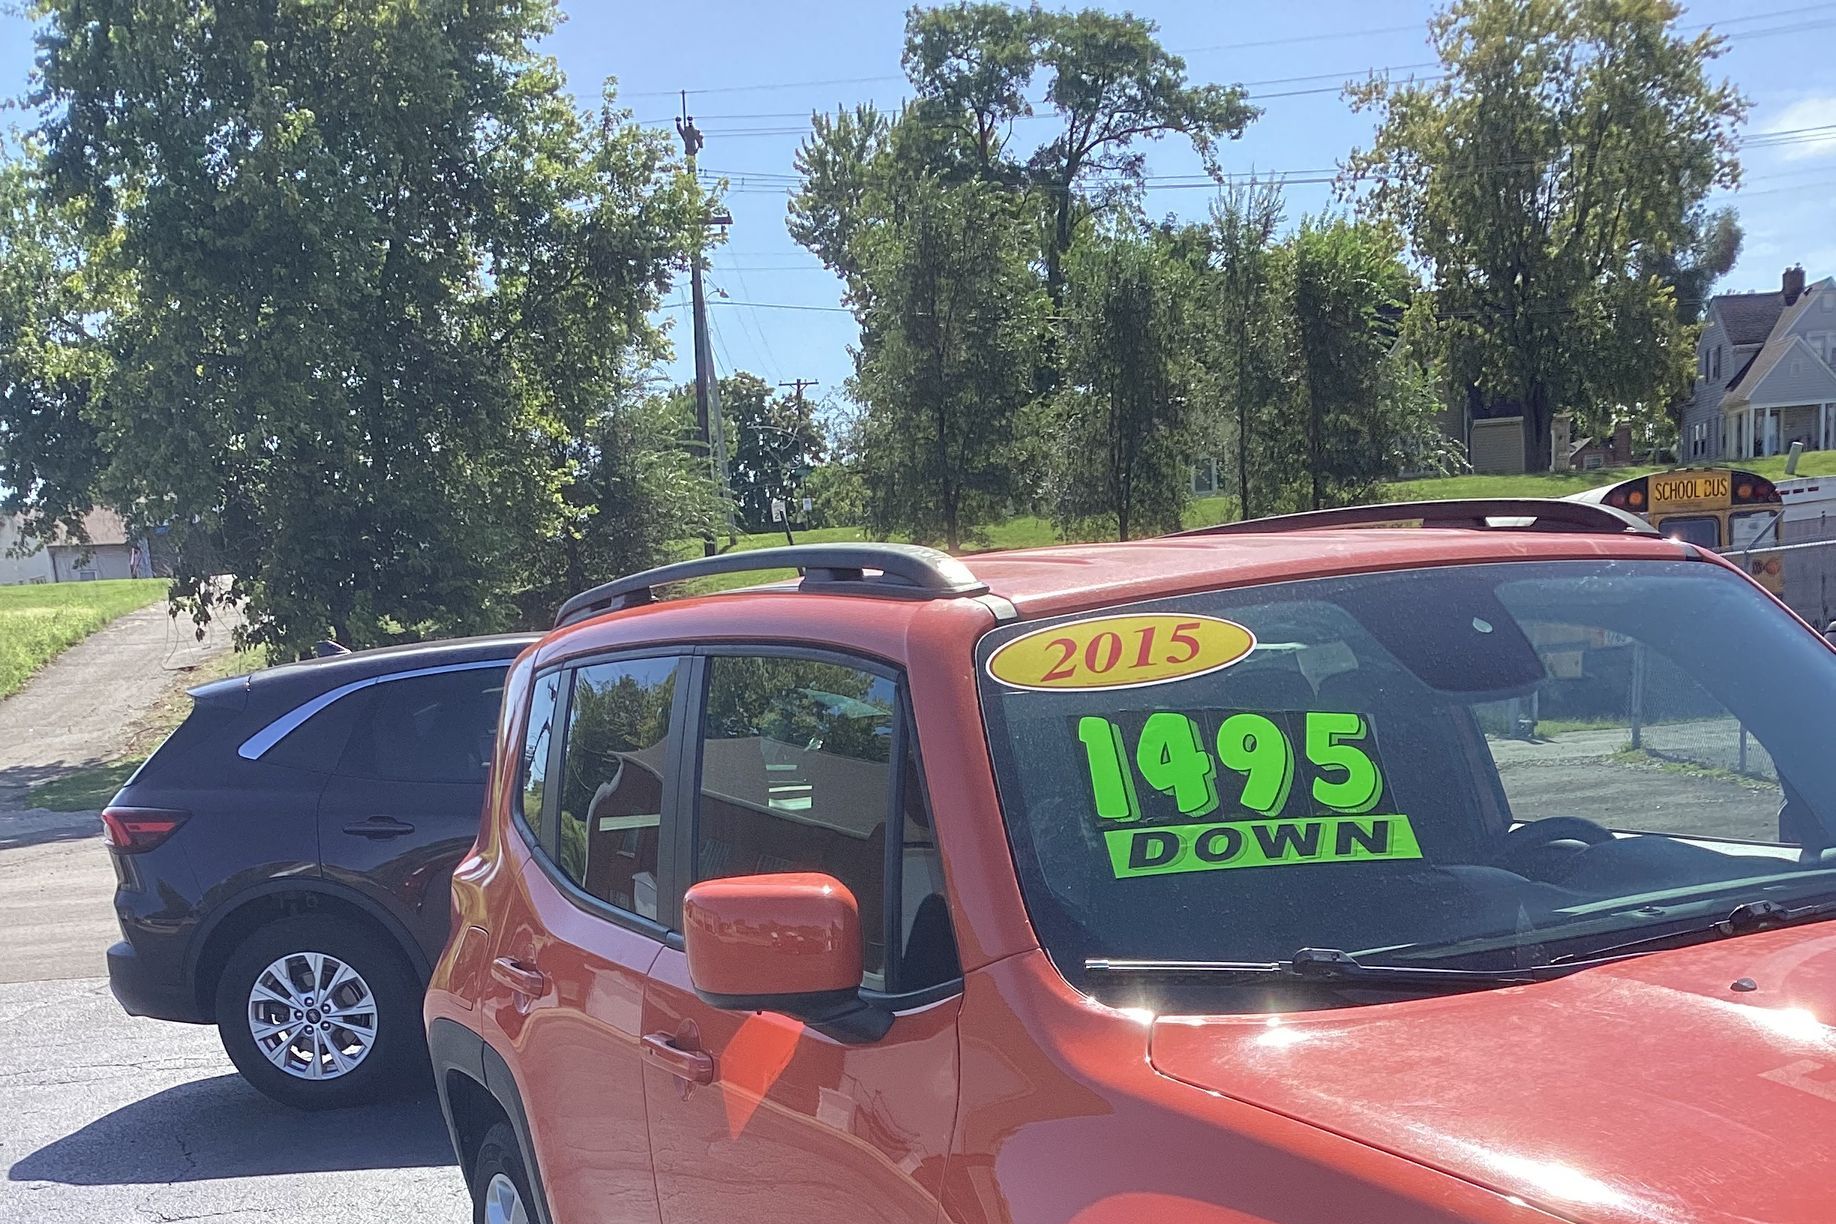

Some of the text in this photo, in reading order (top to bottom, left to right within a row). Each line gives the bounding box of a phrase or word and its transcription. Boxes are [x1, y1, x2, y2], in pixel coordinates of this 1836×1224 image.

[1655, 478, 1728, 501] SCHOOL BUS
[1040, 622, 1201, 683] 2015
[1078, 712, 1384, 822] 1495
[1128, 820, 1394, 870] DOWN
